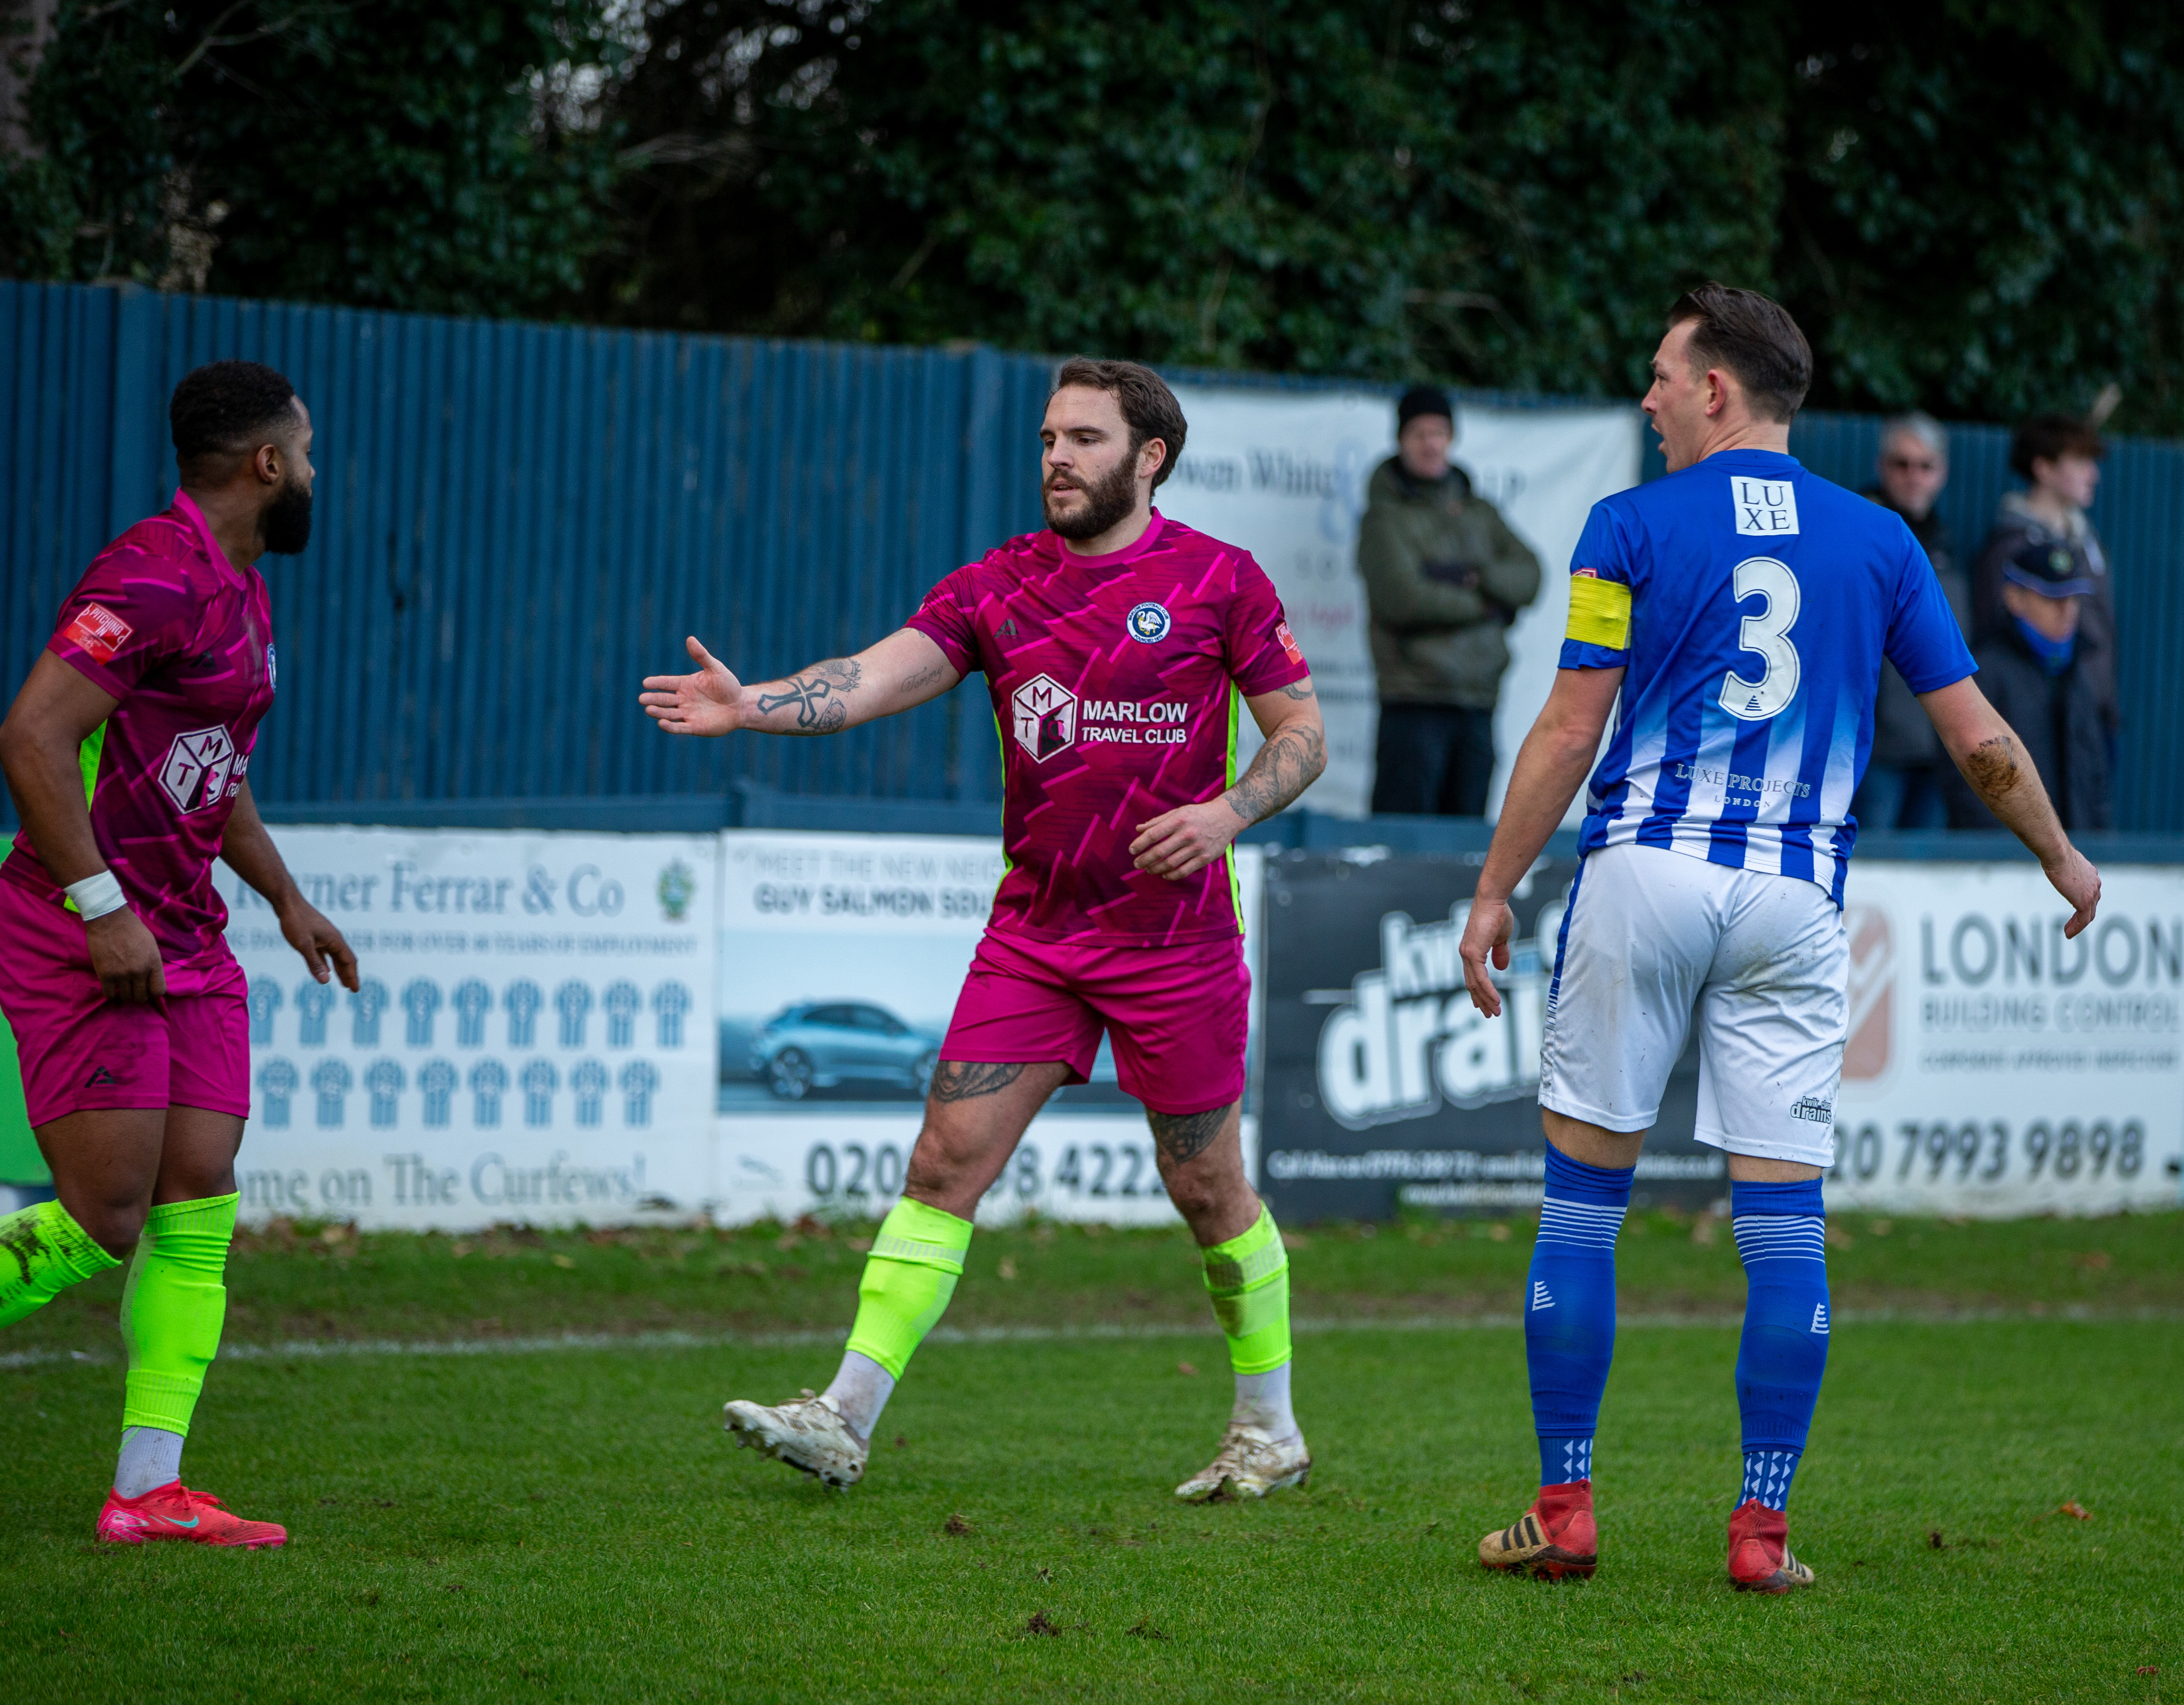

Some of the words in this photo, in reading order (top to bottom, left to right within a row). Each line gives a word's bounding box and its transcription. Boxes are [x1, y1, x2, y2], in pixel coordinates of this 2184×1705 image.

[1739, 482, 1784, 507] LU
[1744, 508, 1791, 531] XE
[89, 607, 124, 636] PITCHING
[1128, 605, 1141, 621] MARLOW
[95, 624, 110, 637] IN
[1718, 556, 1801, 721] 3
[1032, 686, 1052, 708] M
[1082, 700, 1188, 723] MARLOW
[1082, 726, 1143, 743] TRAVEL
[1145, 729, 1187, 744] CLUB
[1675, 763, 1725, 785] LUXE
[1728, 774, 1811, 798] PROJECTS
[1714, 795, 1771, 808] LONDON
[390, 860, 514, 915] Ferrar
[521, 863, 559, 917] &
[566, 863, 625, 918] Co
[819, 883, 934, 918] SALMON
[1921, 913, 2184, 988] LONDON
[1922, 993, 2047, 1032] BUILDING
[2055, 993, 2183, 1033] CONTROL
[1790, 1102, 1832, 1124] drains
[1802, 1096, 1820, 1108] kwik
[1896, 1117, 2009, 1182] 7993
[2025, 1115, 2144, 1181] 9898
[319, 1168, 373, 1207] on
[382, 1151, 462, 1207] The
